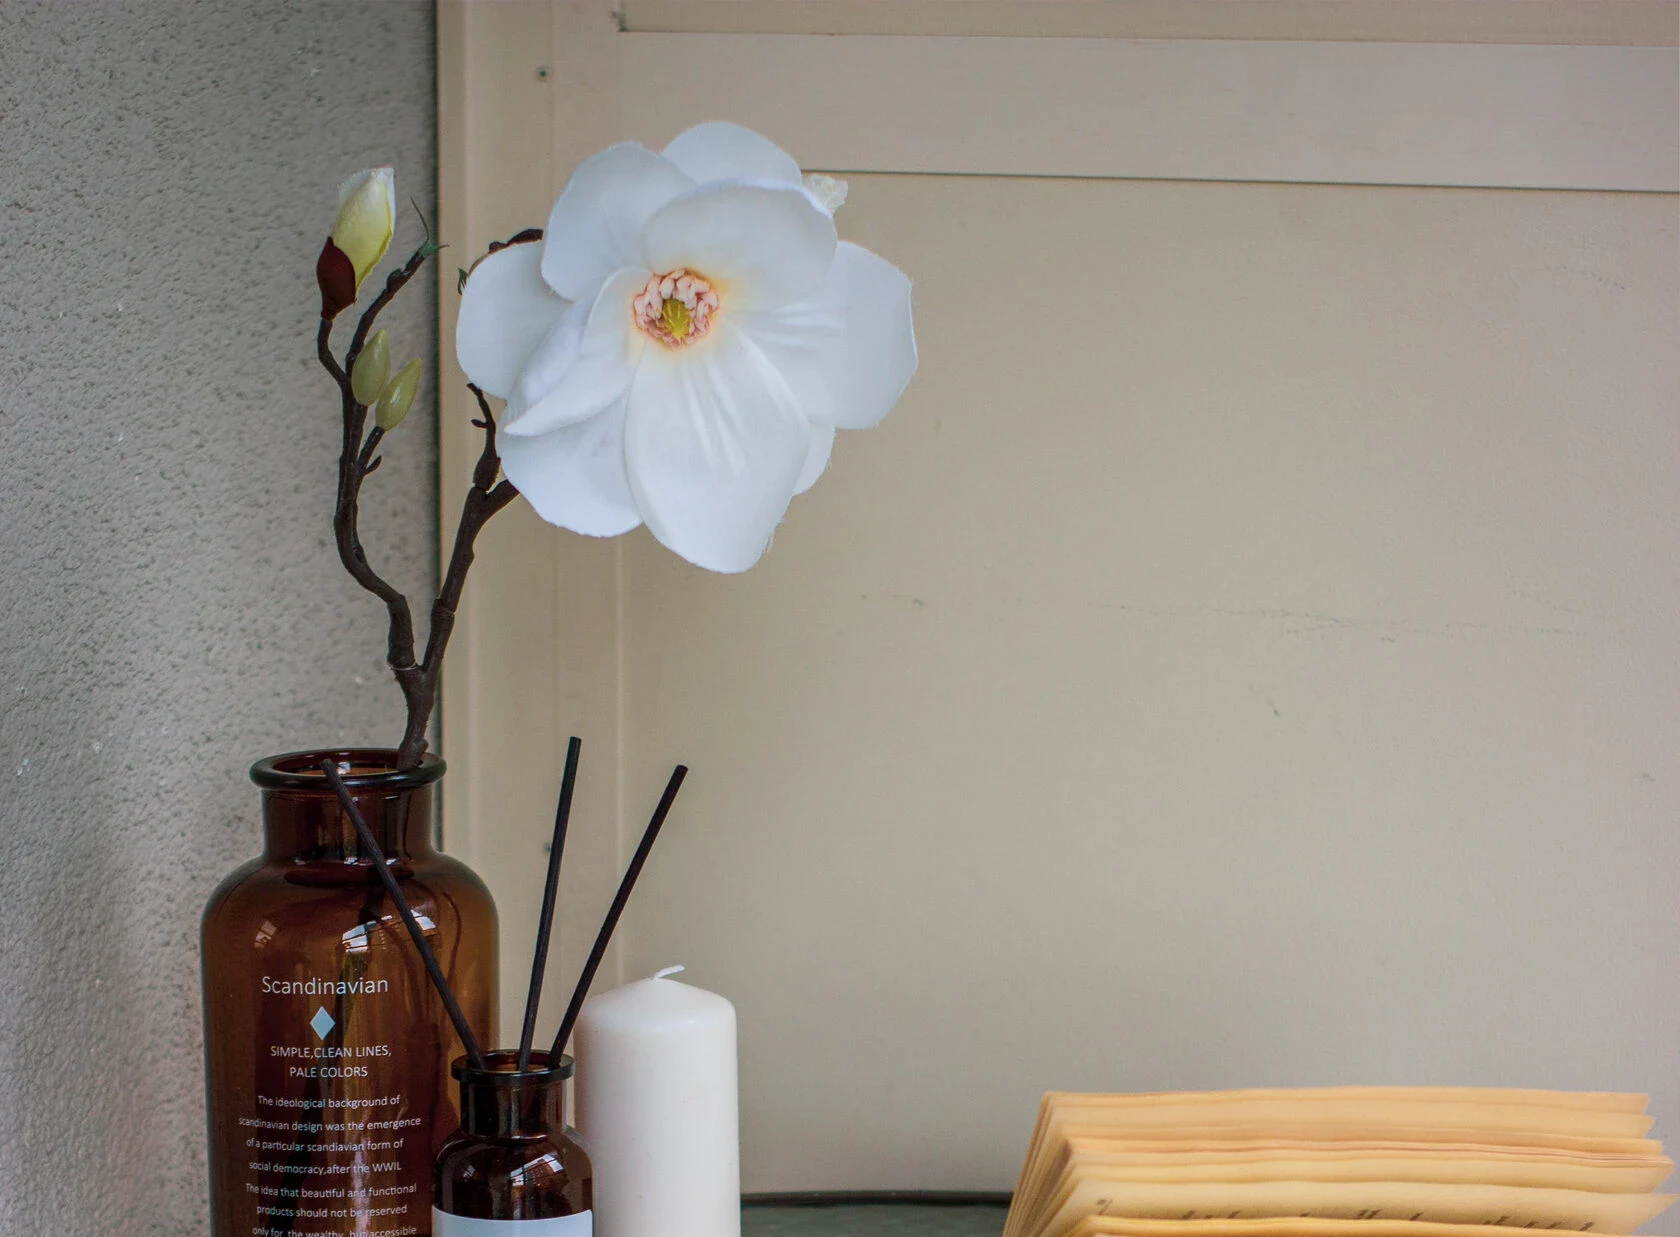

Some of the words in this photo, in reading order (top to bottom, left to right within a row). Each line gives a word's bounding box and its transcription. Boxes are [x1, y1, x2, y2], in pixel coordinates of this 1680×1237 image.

[262, 976, 388, 995] Scandinavian
[271, 1046, 352, 1059] SIMPLE,CLEAN
[356, 1045, 392, 1057] LINES,
[289, 1067, 317, 1077] PALE
[320, 1067, 368, 1077] COLORS
[258, 1096, 273, 1105] The
[275, 1097, 326, 1109] ideological
[328, 1098, 387, 1109] background
[390, 1095, 400, 1104] of
[238, 1117, 289, 1130] scandinavian
[292, 1121, 322, 1133] design
[325, 1123, 344, 1131] was
[348, 1121, 364, 1130] the
[367, 1117, 421, 1130] emergence
[246, 1138, 255, 1147] of
[262, 1142, 304, 1151] particular
[367, 1141, 391, 1150] form
[393, 1138, 404, 1148] of
[249, 1162, 271, 1171] social
[273, 1164, 350, 1176] democracy,after
[353, 1164, 370, 1173] the
[246, 1183, 260, 1193] The
[261, 1186, 278, 1196] idea
[281, 1188, 299, 1198] that
[301, 1188, 344, 1198] beautiful
[348, 1189, 366, 1198] and
[369, 1183, 417, 1196] functional
[256, 1206, 294, 1217] products
[296, 1208, 328, 1217] should
[331, 1209, 347, 1217] not
[350, 1208, 362, 1217] be
[366, 1205, 407, 1216] reserved
[253, 1227, 269, 1237] only
[271, 1229, 283, 1237] for
[369, 1226, 417, 1237] accessible
